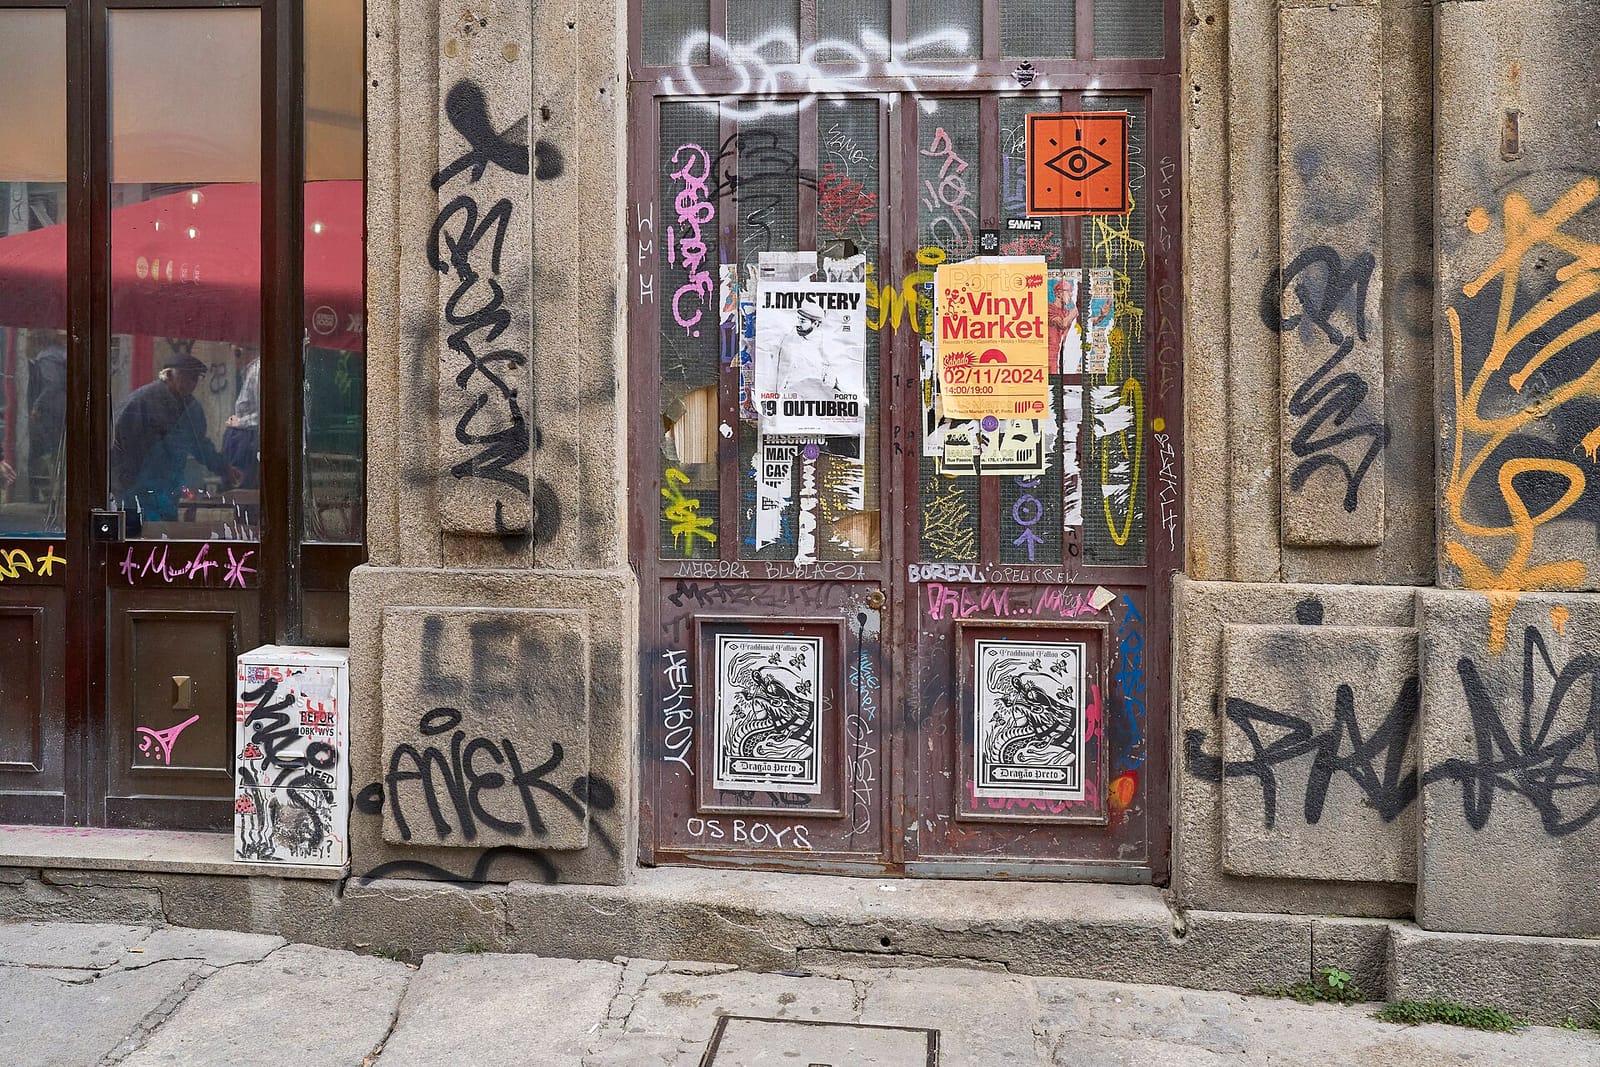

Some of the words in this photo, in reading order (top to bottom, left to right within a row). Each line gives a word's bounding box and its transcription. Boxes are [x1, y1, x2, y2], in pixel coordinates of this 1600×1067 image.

[1008, 220, 1041, 230] SAMI-R
[949, 268, 1026, 292] Porto
[762, 292, 860, 309] J.MYSTERY
[967, 292, 1033, 320] Vinyl
[943, 315, 1043, 339] Market
[944, 369, 1044, 384] 02/11/2024
[945, 386, 993, 394] 14:00/19:00
[783, 401, 859, 416] OUTUBRO
[766, 447, 796, 460] MAIS
[740, 761, 771, 774] Dragão
[774, 762, 796, 773] Preto
[1000, 768, 1032, 780] Dragão
[1035, 769, 1058, 780] Preto
[304, 767, 334, 784] NEED
[687, 818, 725, 838] OS
[734, 820, 813, 850] BOYS
